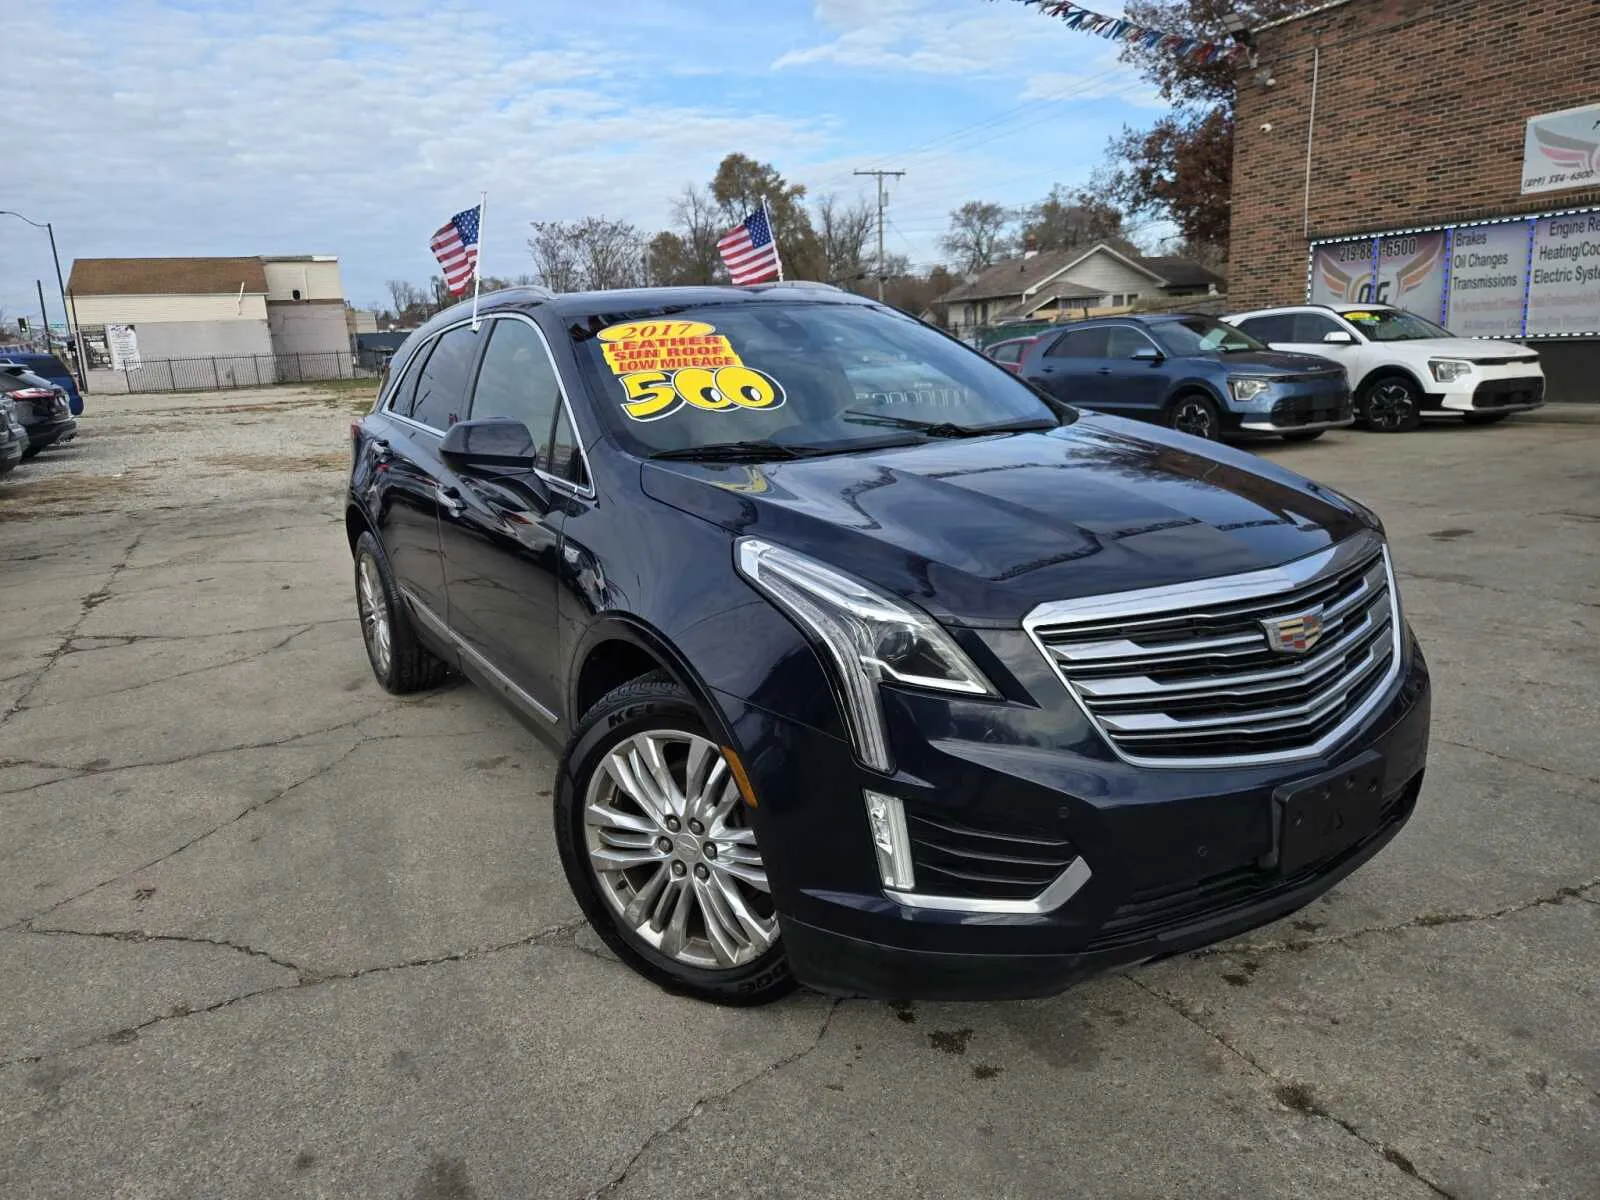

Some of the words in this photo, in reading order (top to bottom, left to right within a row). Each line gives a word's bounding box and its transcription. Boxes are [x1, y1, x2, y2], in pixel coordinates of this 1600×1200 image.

[1549, 220, 1584, 239] Engine
[1456, 231, 1487, 247] Brakes
[1339, 238, 1417, 262] 219-88-6500
[1454, 254, 1467, 269] Oil
[1468, 252, 1508, 269] Changes
[1453, 274, 1517, 290] Transmissions
[1534, 268, 1572, 285] Electric
[622, 323, 694, 340] 2017
[608, 336, 722, 352] LEATHER
[613, 349, 660, 361] SUN
[666, 346, 725, 357] ROOF
[619, 358, 657, 371] LOW
[660, 356, 736, 369] MILEAGE
[619, 366, 786, 422] 500
